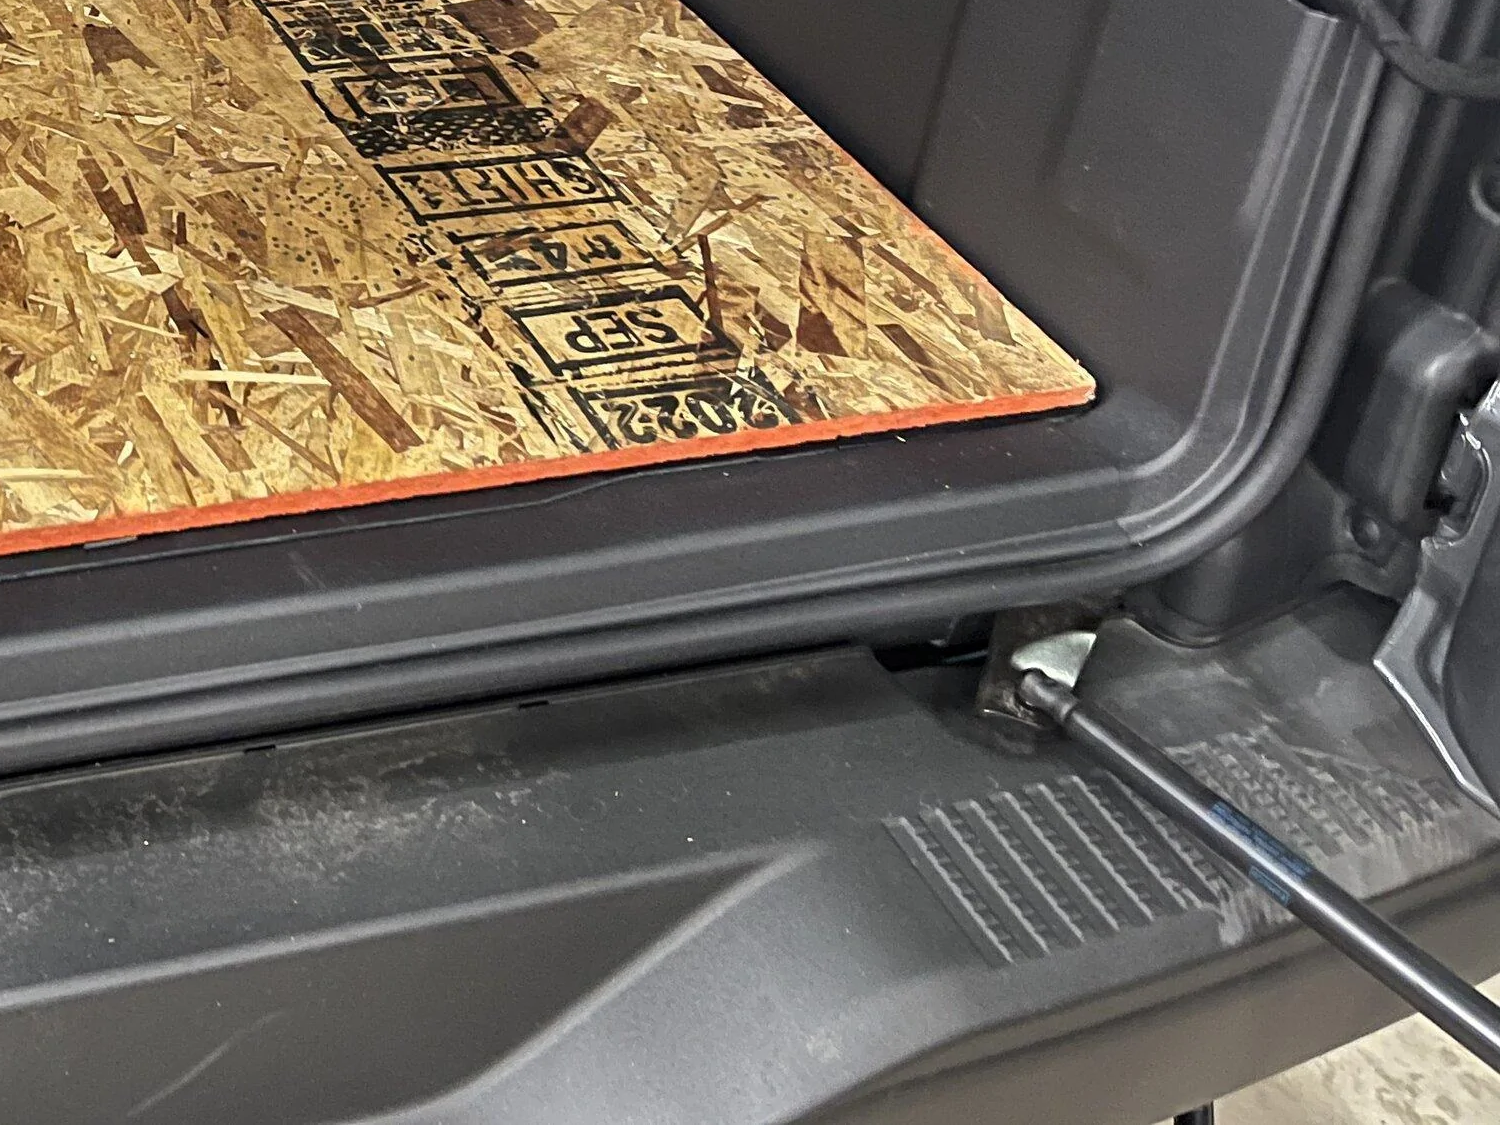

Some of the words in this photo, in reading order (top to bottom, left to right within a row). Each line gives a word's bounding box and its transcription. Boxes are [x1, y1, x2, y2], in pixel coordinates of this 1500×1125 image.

[445, 159, 597, 206] SHIFT
[565, 309, 678, 353] SEP
[600, 390, 779, 443] 2022
